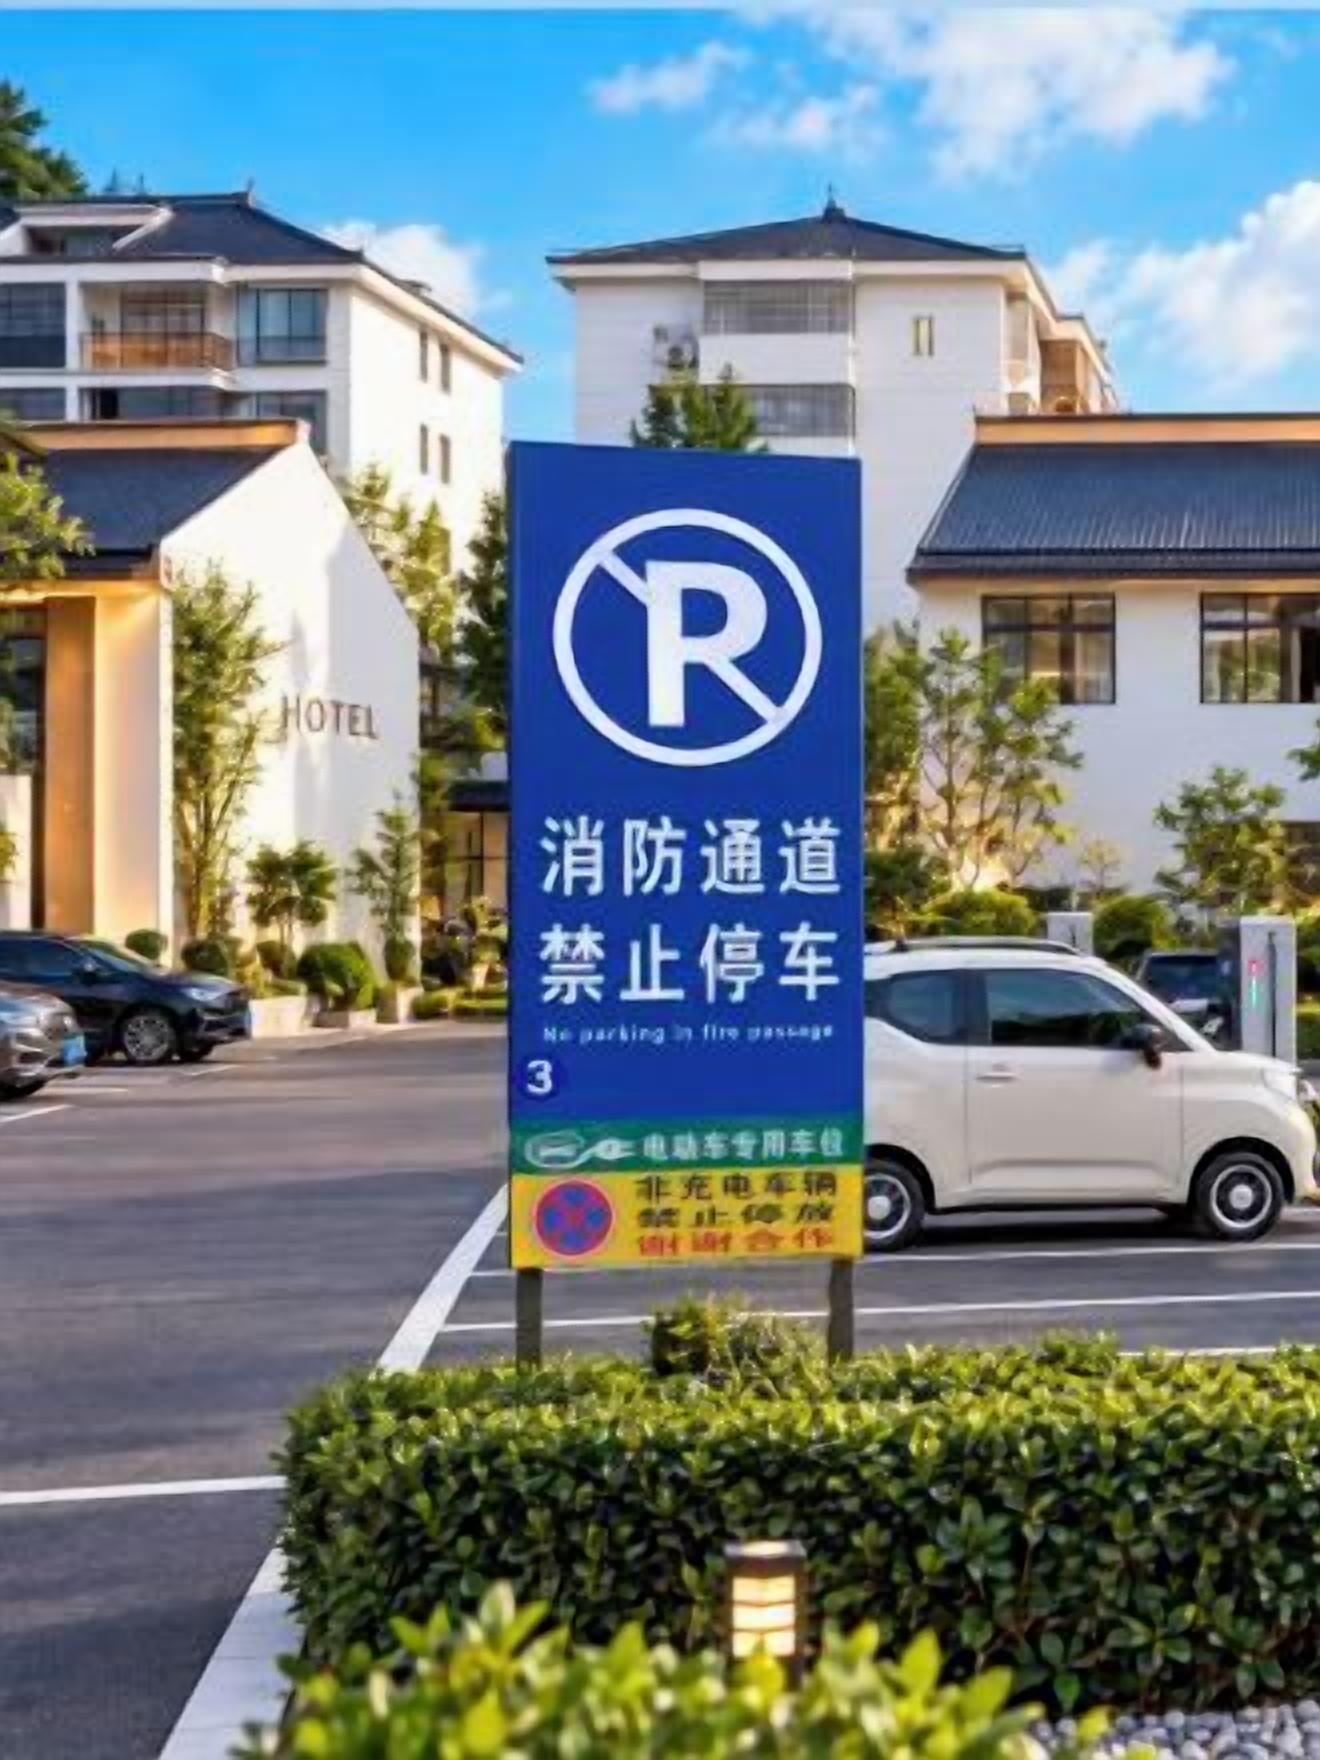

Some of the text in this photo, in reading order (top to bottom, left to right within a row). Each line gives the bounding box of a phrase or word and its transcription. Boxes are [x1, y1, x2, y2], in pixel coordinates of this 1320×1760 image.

[281, 693, 379, 741] HOTEL
[539, 815, 842, 897] 消防通道
[539, 921, 840, 1005] 禁止停车
[579, 1023, 665, 1045] parking
[526, 1059, 553, 1095] 3
[633, 1171, 837, 1203] 非充电车辆
